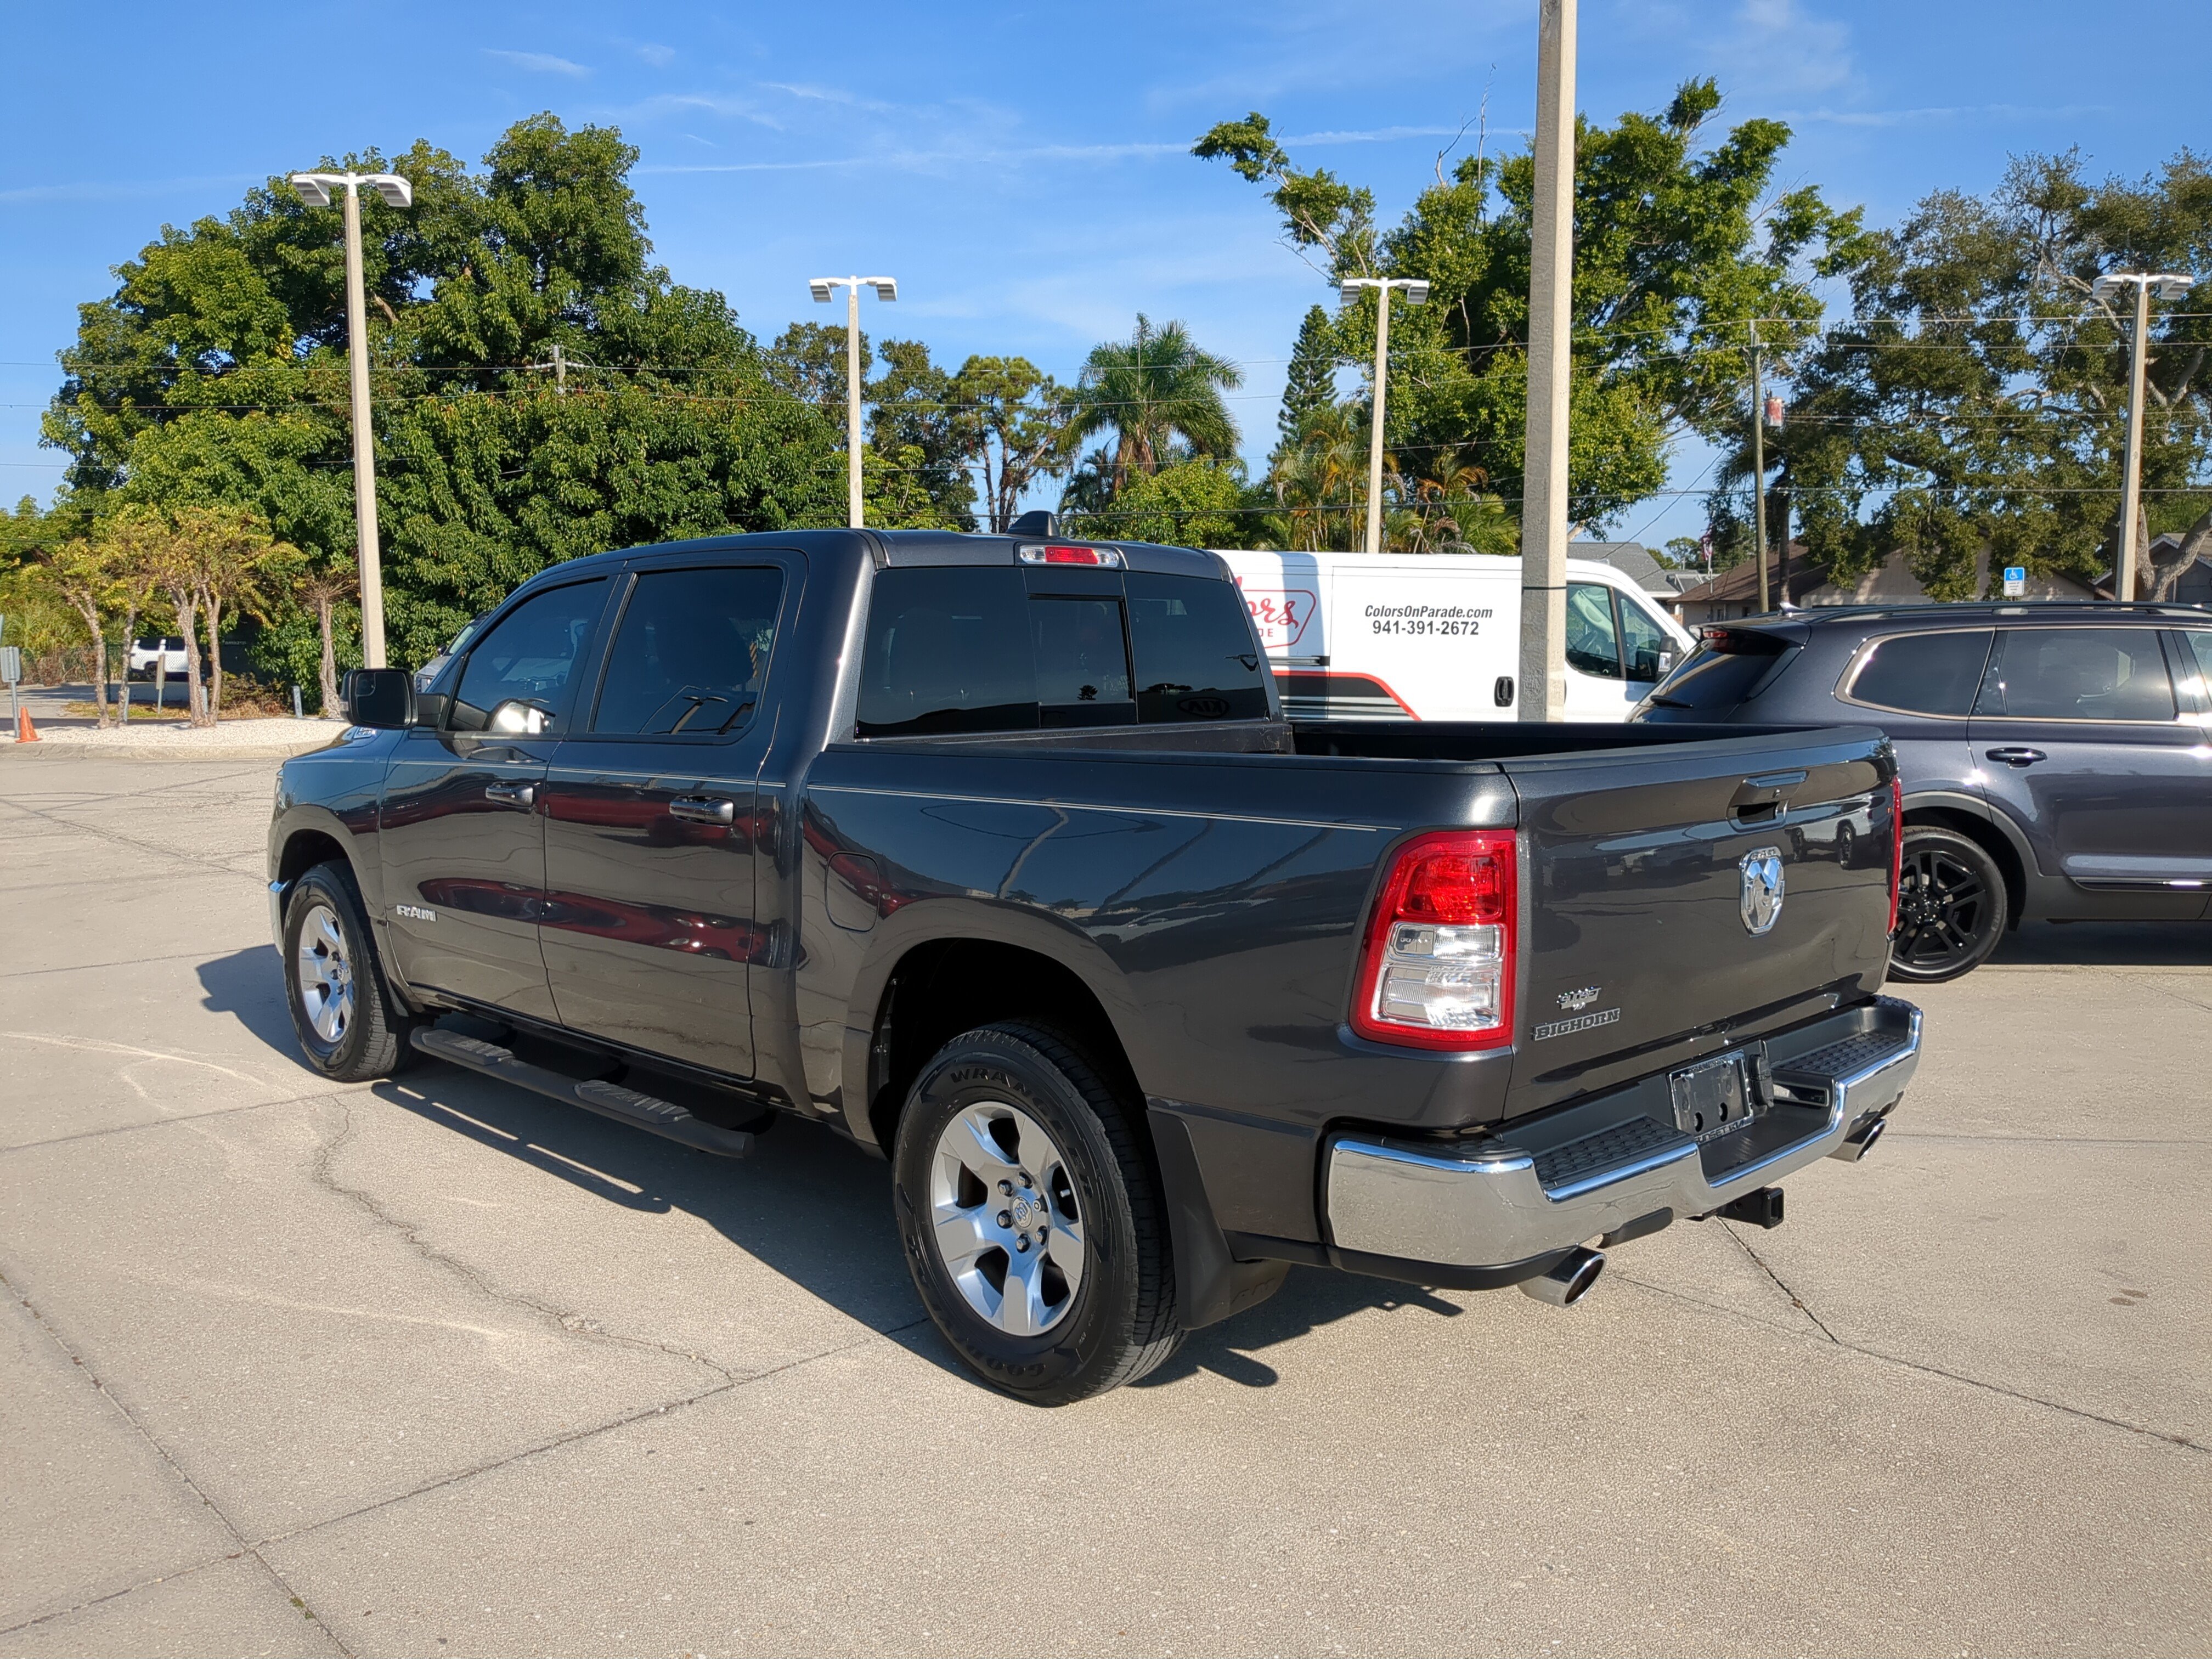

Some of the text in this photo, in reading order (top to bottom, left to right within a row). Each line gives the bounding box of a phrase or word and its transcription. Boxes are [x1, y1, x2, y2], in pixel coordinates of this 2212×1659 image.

[1242, 590, 1299, 629] ors
[1365, 605, 1493, 618] ColorsOnParade.com
[1373, 620, 1479, 635] 941-391-2672
[397, 904, 437, 922] RAM
